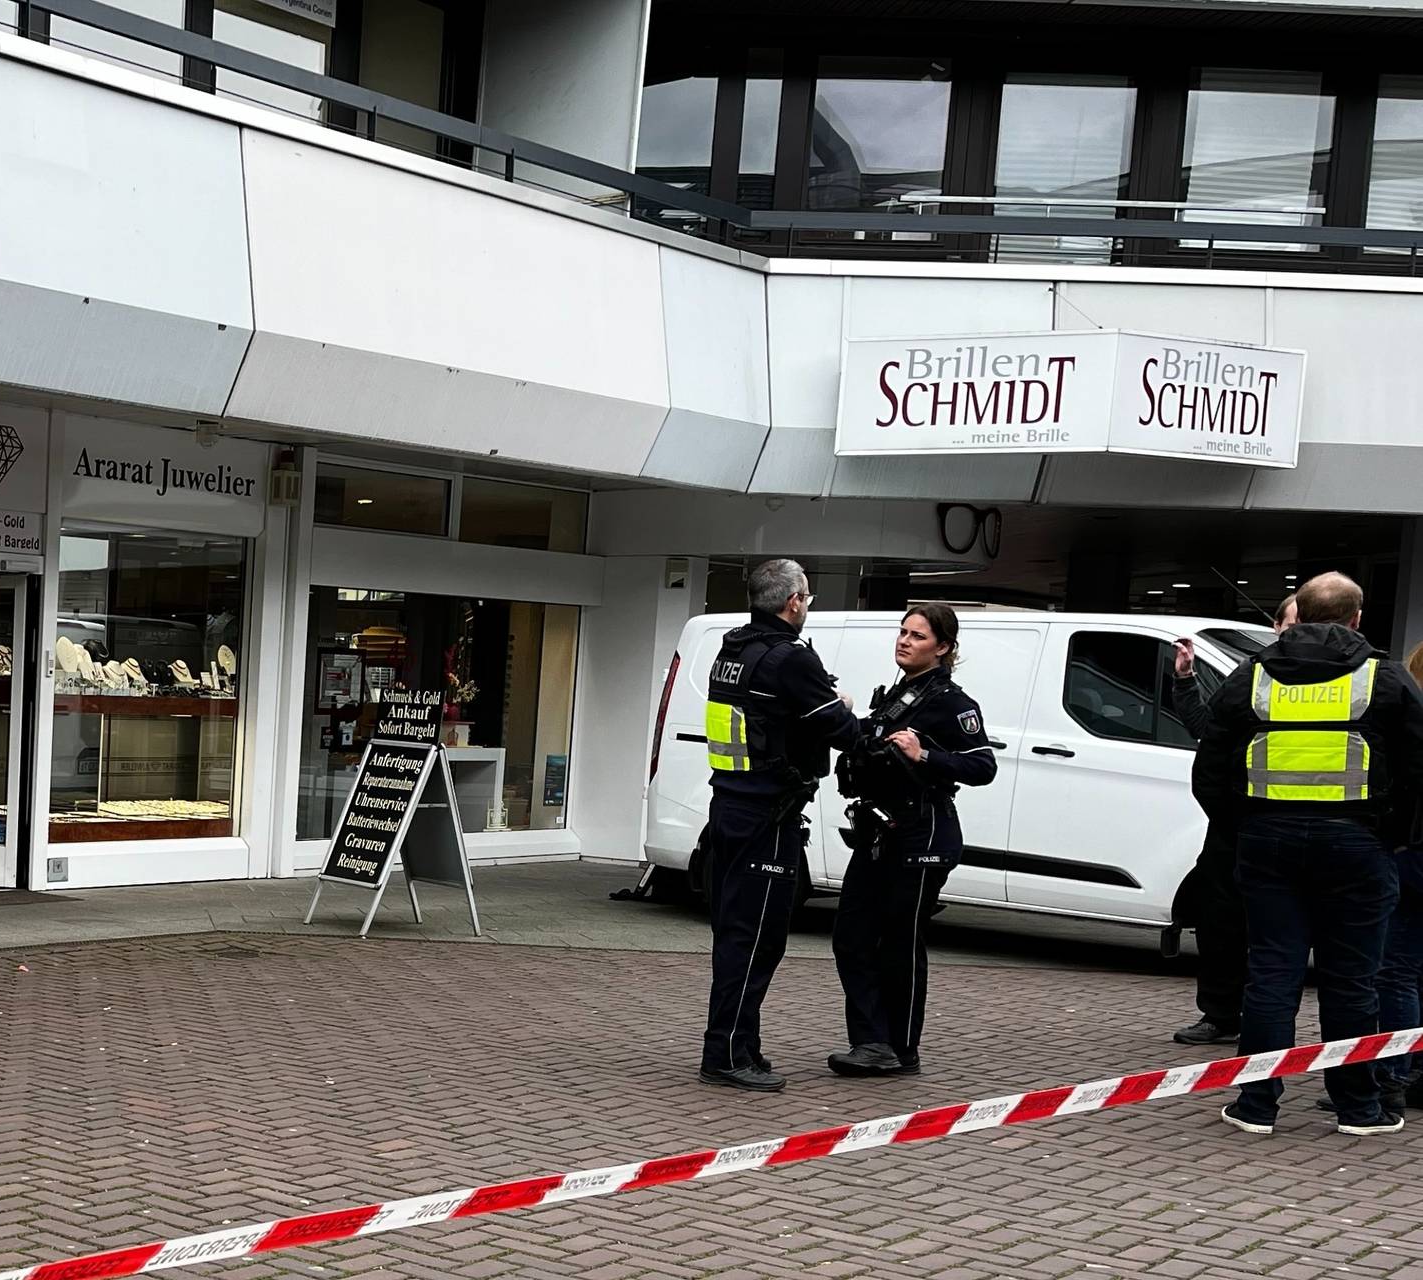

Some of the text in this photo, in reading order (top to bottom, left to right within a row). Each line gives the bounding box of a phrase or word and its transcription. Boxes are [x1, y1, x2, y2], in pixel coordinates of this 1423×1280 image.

[905, 346, 1041, 380] Brillen
[1161, 347, 1255, 388] Brillen
[875, 356, 1076, 429] SCHMIDT
[1138, 357, 1278, 438] SCHMIDT
[971, 431, 1020, 445] meine
[1026, 428, 1071, 445] Brille
[1205, 439, 1240, 455] meine
[1243, 441, 1273, 458] Brille
[72, 447, 256, 497] Ararat Juwelier
[4, 535, 40, 550] Bargeld
[710, 659, 745, 685] OLIZEI
[383, 688, 441, 706] Schmuck & Gold
[1276, 685, 1345, 704] POLIZEI
[387, 704, 432, 721] Ankauf
[378, 719, 436, 740] Sofort Bargeld
[369, 752, 424, 775] Anfertigung
[355, 792, 408, 813] Uhrenservice
[346, 811, 402, 833] Batteriewechsel
[344, 832, 387, 852] Gravuren
[336, 853, 378, 876] Reinigung
[761, 863, 785, 874] POLIZEI
